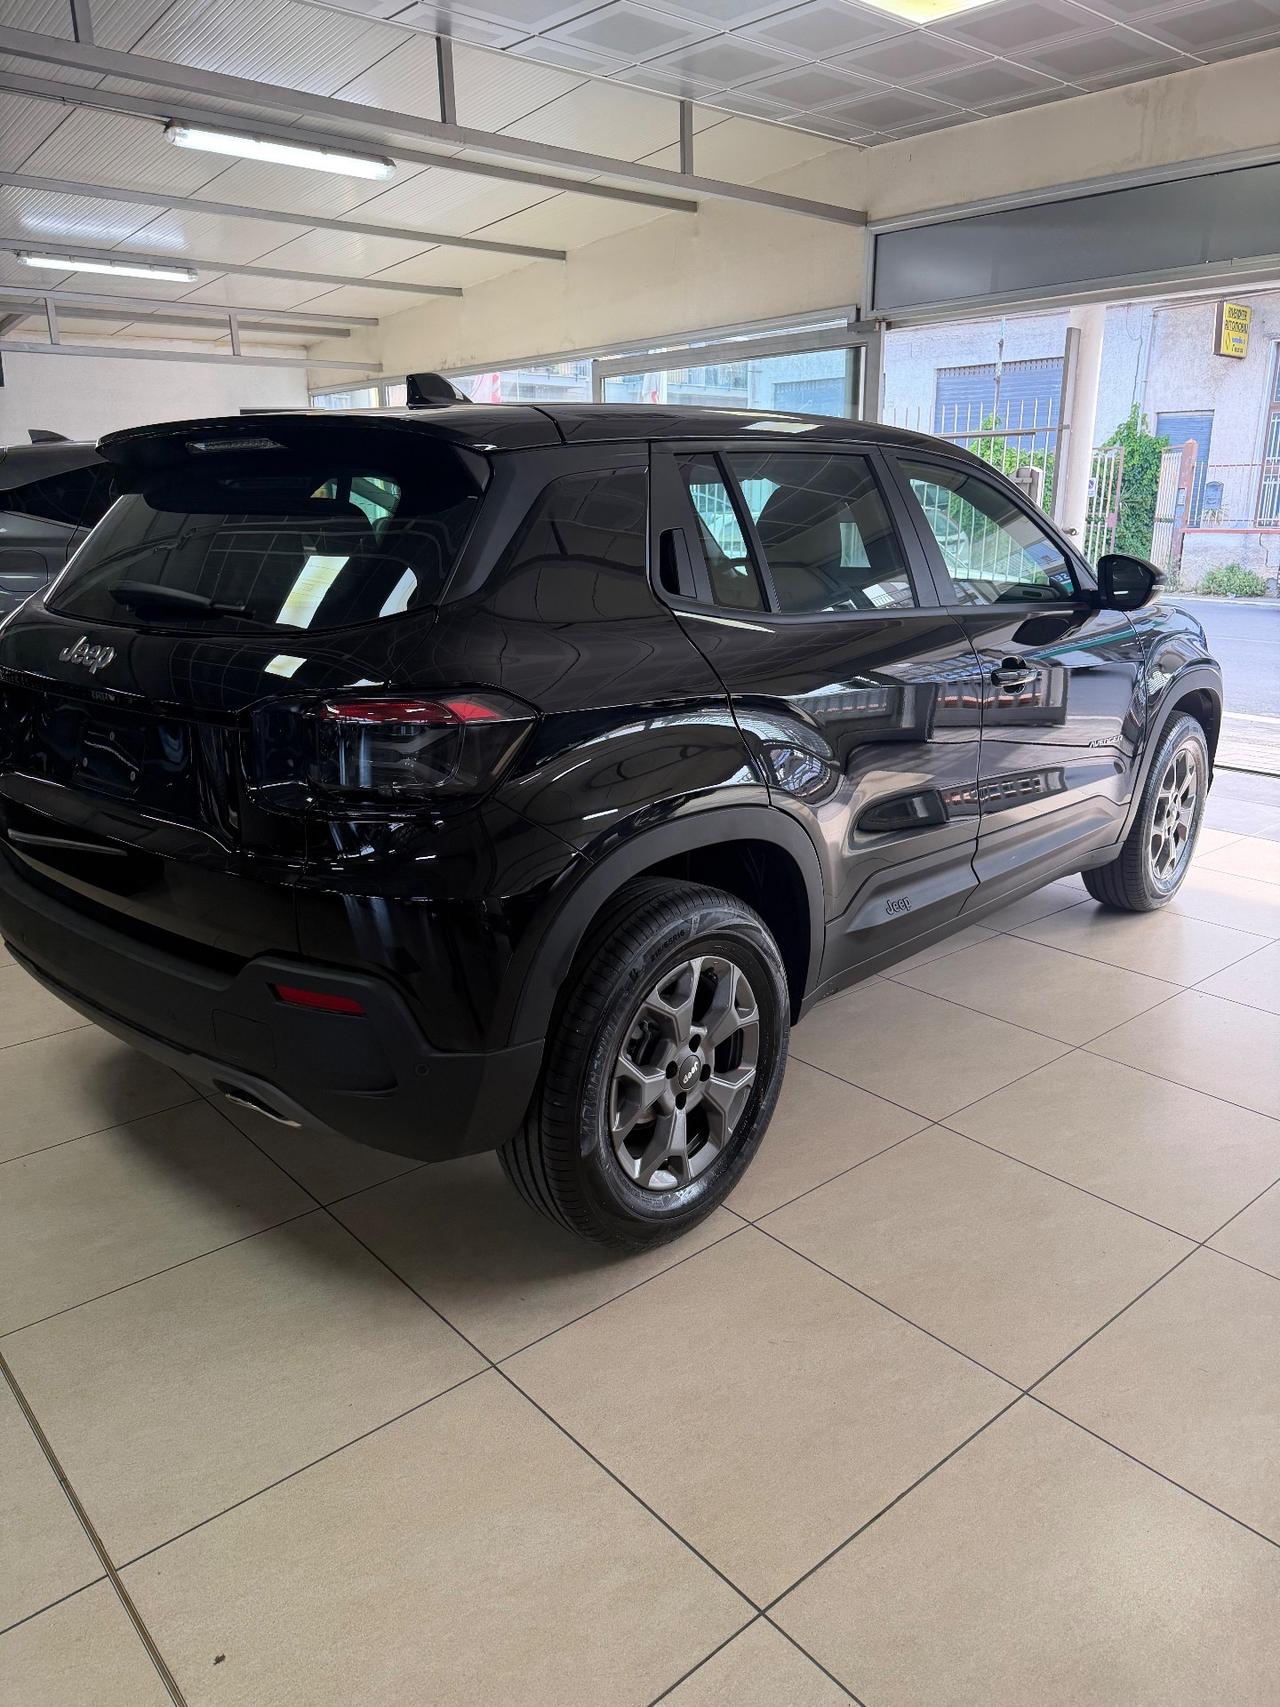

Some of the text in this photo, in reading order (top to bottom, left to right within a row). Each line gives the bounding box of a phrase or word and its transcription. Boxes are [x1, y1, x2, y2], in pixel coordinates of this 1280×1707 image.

[58, 636, 115, 674] Jeep
[886, 896, 911, 915] Jeep
[683, 1061, 699, 1084] Jeep
